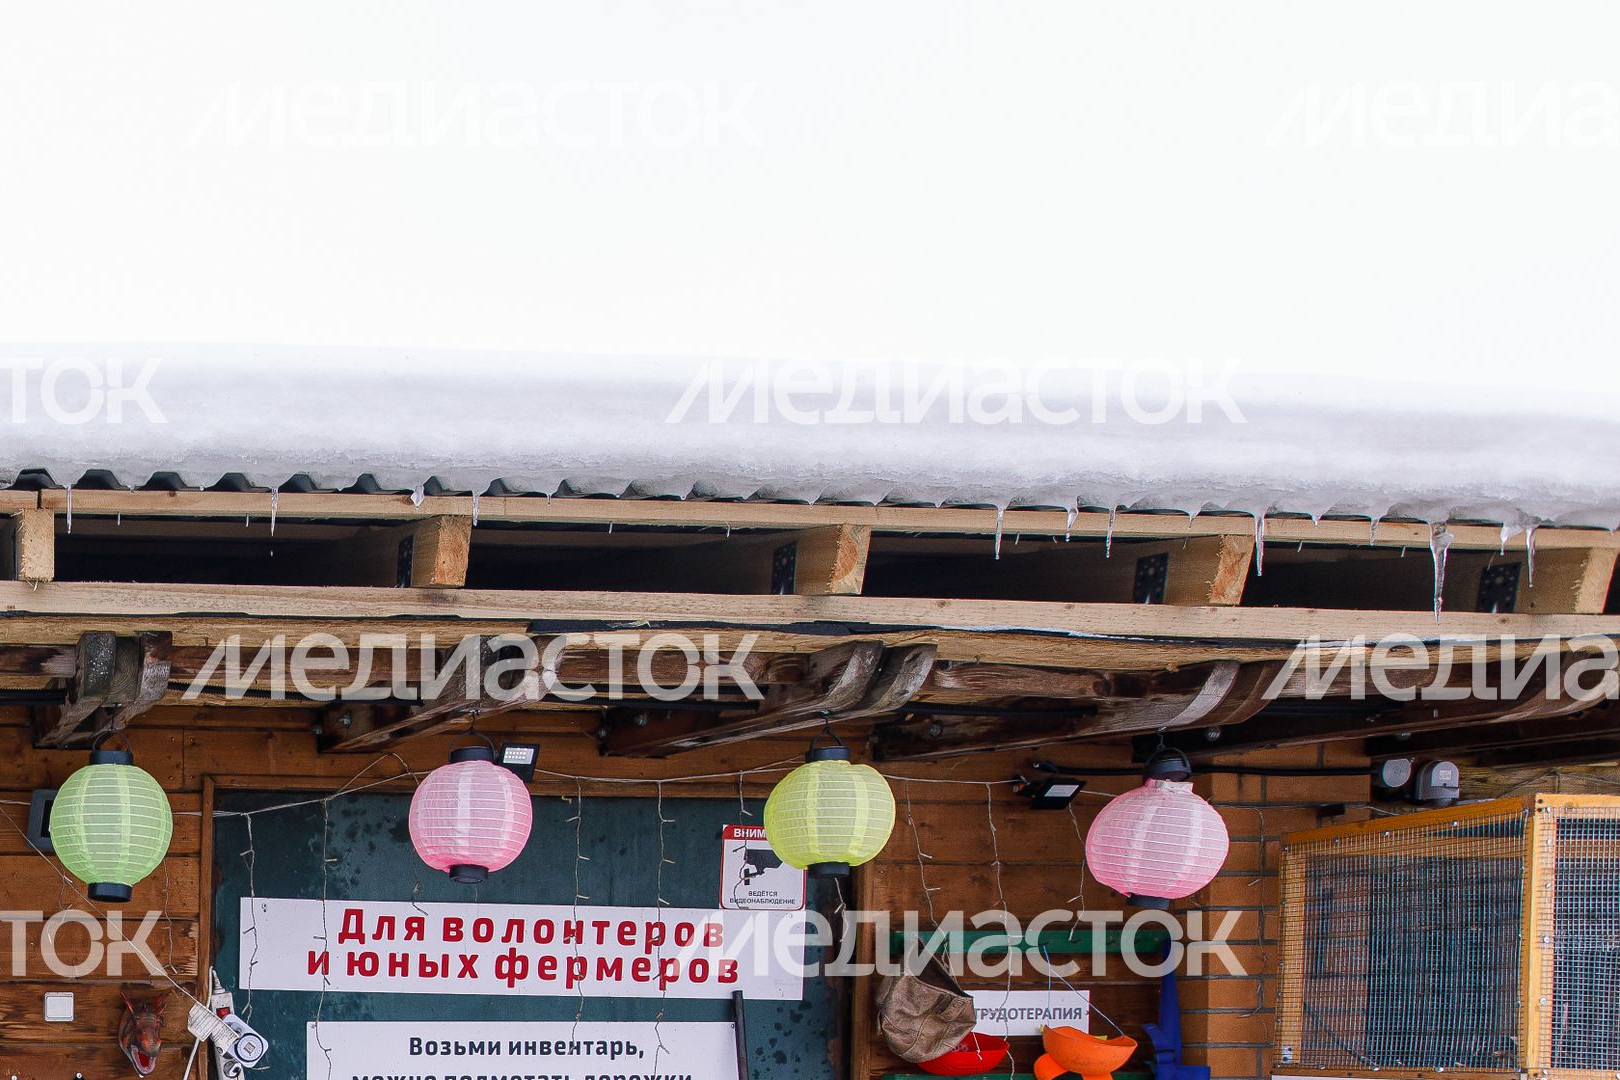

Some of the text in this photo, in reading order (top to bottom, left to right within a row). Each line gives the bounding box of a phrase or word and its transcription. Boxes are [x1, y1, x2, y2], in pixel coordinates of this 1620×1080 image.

[733, 828, 767, 838] ВНИМ
[338, 908, 725, 948] Для волонтеров
[306, 948, 740, 992] и юных фермеров
[975, 1008, 1082, 1023] ТРУДОТЕРАПИЯ
[409, 1037, 645, 1060] Возьми инвентарь,
